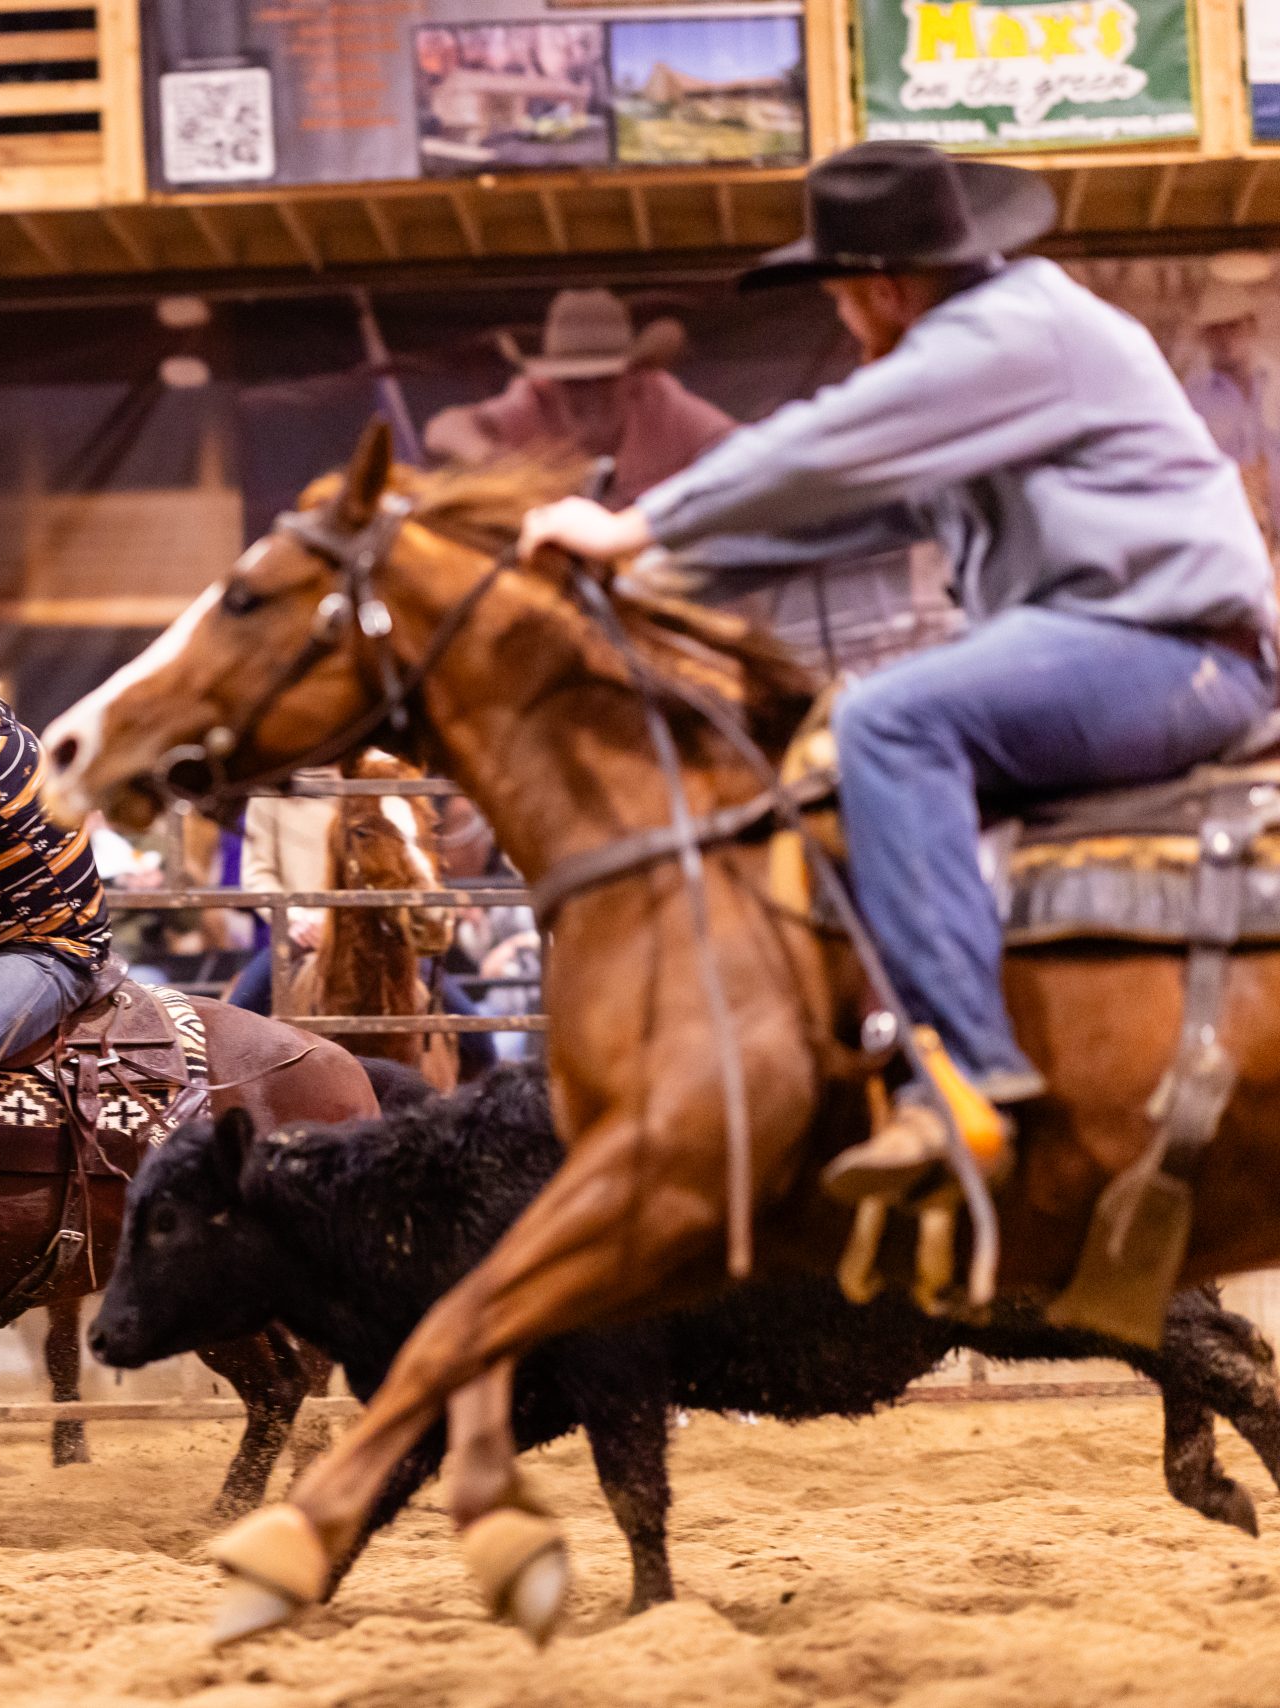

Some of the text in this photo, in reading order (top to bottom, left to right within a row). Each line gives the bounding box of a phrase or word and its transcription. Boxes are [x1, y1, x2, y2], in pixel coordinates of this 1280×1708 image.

[914, 1, 1127, 63] Max's
[966, 61, 1020, 97] the
[1022, 74, 1131, 117] green
